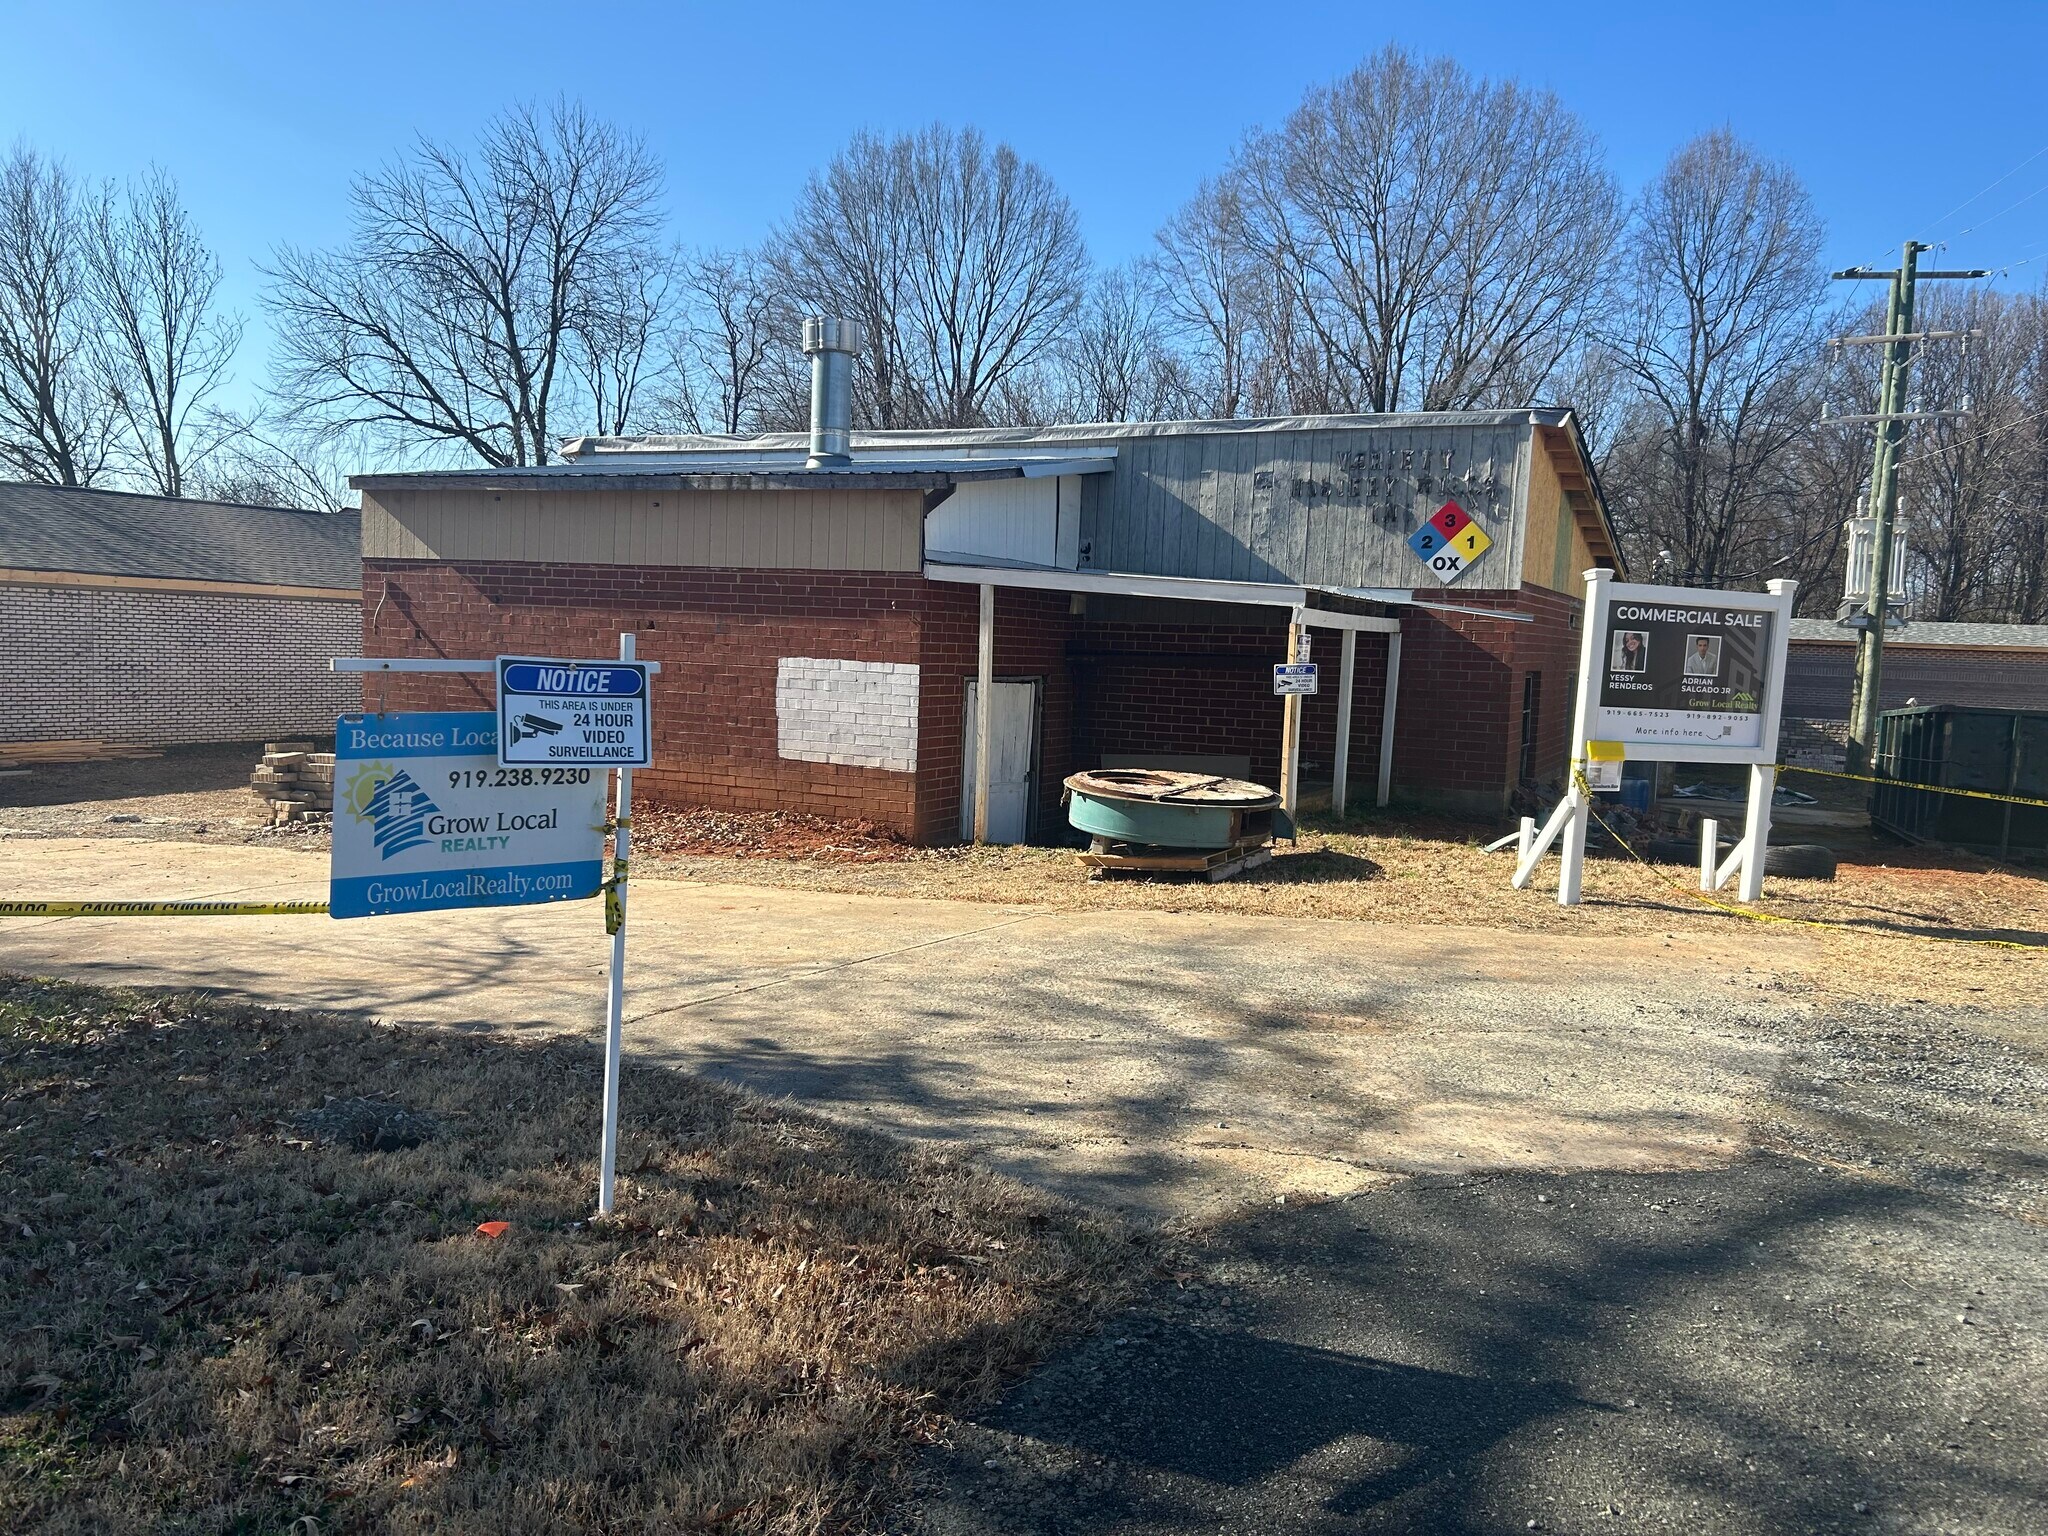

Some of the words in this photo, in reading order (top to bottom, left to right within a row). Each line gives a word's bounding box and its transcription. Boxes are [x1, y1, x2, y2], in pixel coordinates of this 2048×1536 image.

[1444, 514, 1456, 528] 3
[1422, 535, 1433, 548] 2
[1466, 536, 1475, 549] 1
[1432, 556, 1460, 570] OX
[1616, 606, 1721, 626] COMMERCIAL
[1724, 612, 1763, 628] SALE
[537, 668, 612, 692] NOTICE
[1609, 674, 1635, 682] YESSY
[1681, 678, 1713, 686] ADRIAN
[1609, 682, 1653, 691] RENDEROS
[1681, 686, 1720, 694] SALGADO
[539, 700, 560, 710] THIS
[562, 700, 586, 710] AREA
[589, 701, 598, 711] IS
[601, 702, 633, 712] UNDER
[1688, 698, 1710, 707] Grow
[1712, 700, 1733, 708] Local
[1735, 700, 1758, 711] Realty
[574, 713, 590, 727] 24
[595, 714, 633, 727] HOUR
[350, 729, 443, 749] Because
[451, 727, 498, 747] Loca
[583, 730, 625, 744] VIDEO
[1635, 727, 1658, 735] More
[1661, 727, 1679, 736] info
[1683, 728, 1703, 736] here
[548, 746, 634, 758] SURVEILLANCE
[449, 768, 590, 789] 919.238.9230
[428, 816, 489, 835] Grow
[496, 808, 558, 831] Local
[441, 836, 510, 853] REALTY
[367, 872, 573, 905] GrowLocalRealty.com
